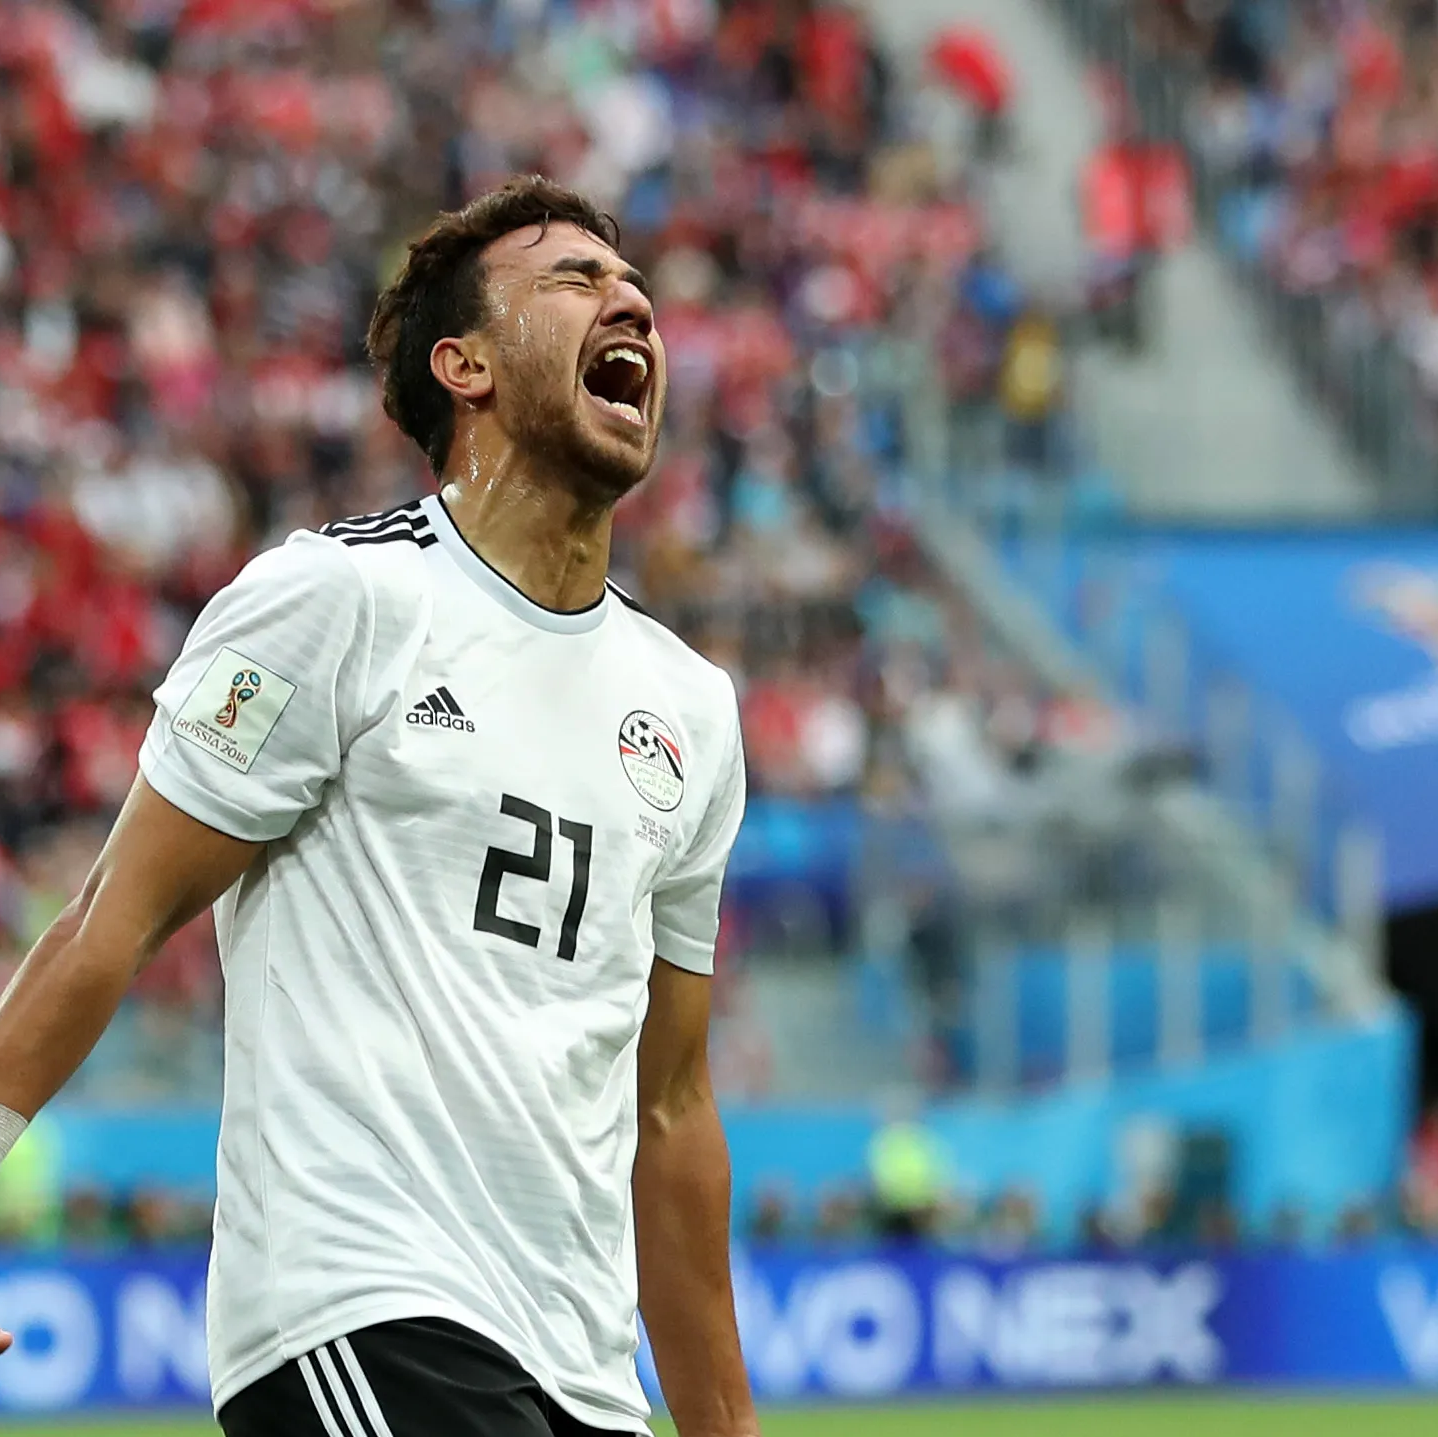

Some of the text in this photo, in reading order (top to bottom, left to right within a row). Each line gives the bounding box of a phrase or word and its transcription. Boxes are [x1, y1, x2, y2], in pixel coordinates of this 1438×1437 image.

[176, 717, 248, 765] RUSSIA 2018
[406, 709, 475, 733] adidas
[472, 792, 593, 961] 21
[929, 1262, 1225, 1390] NEX
